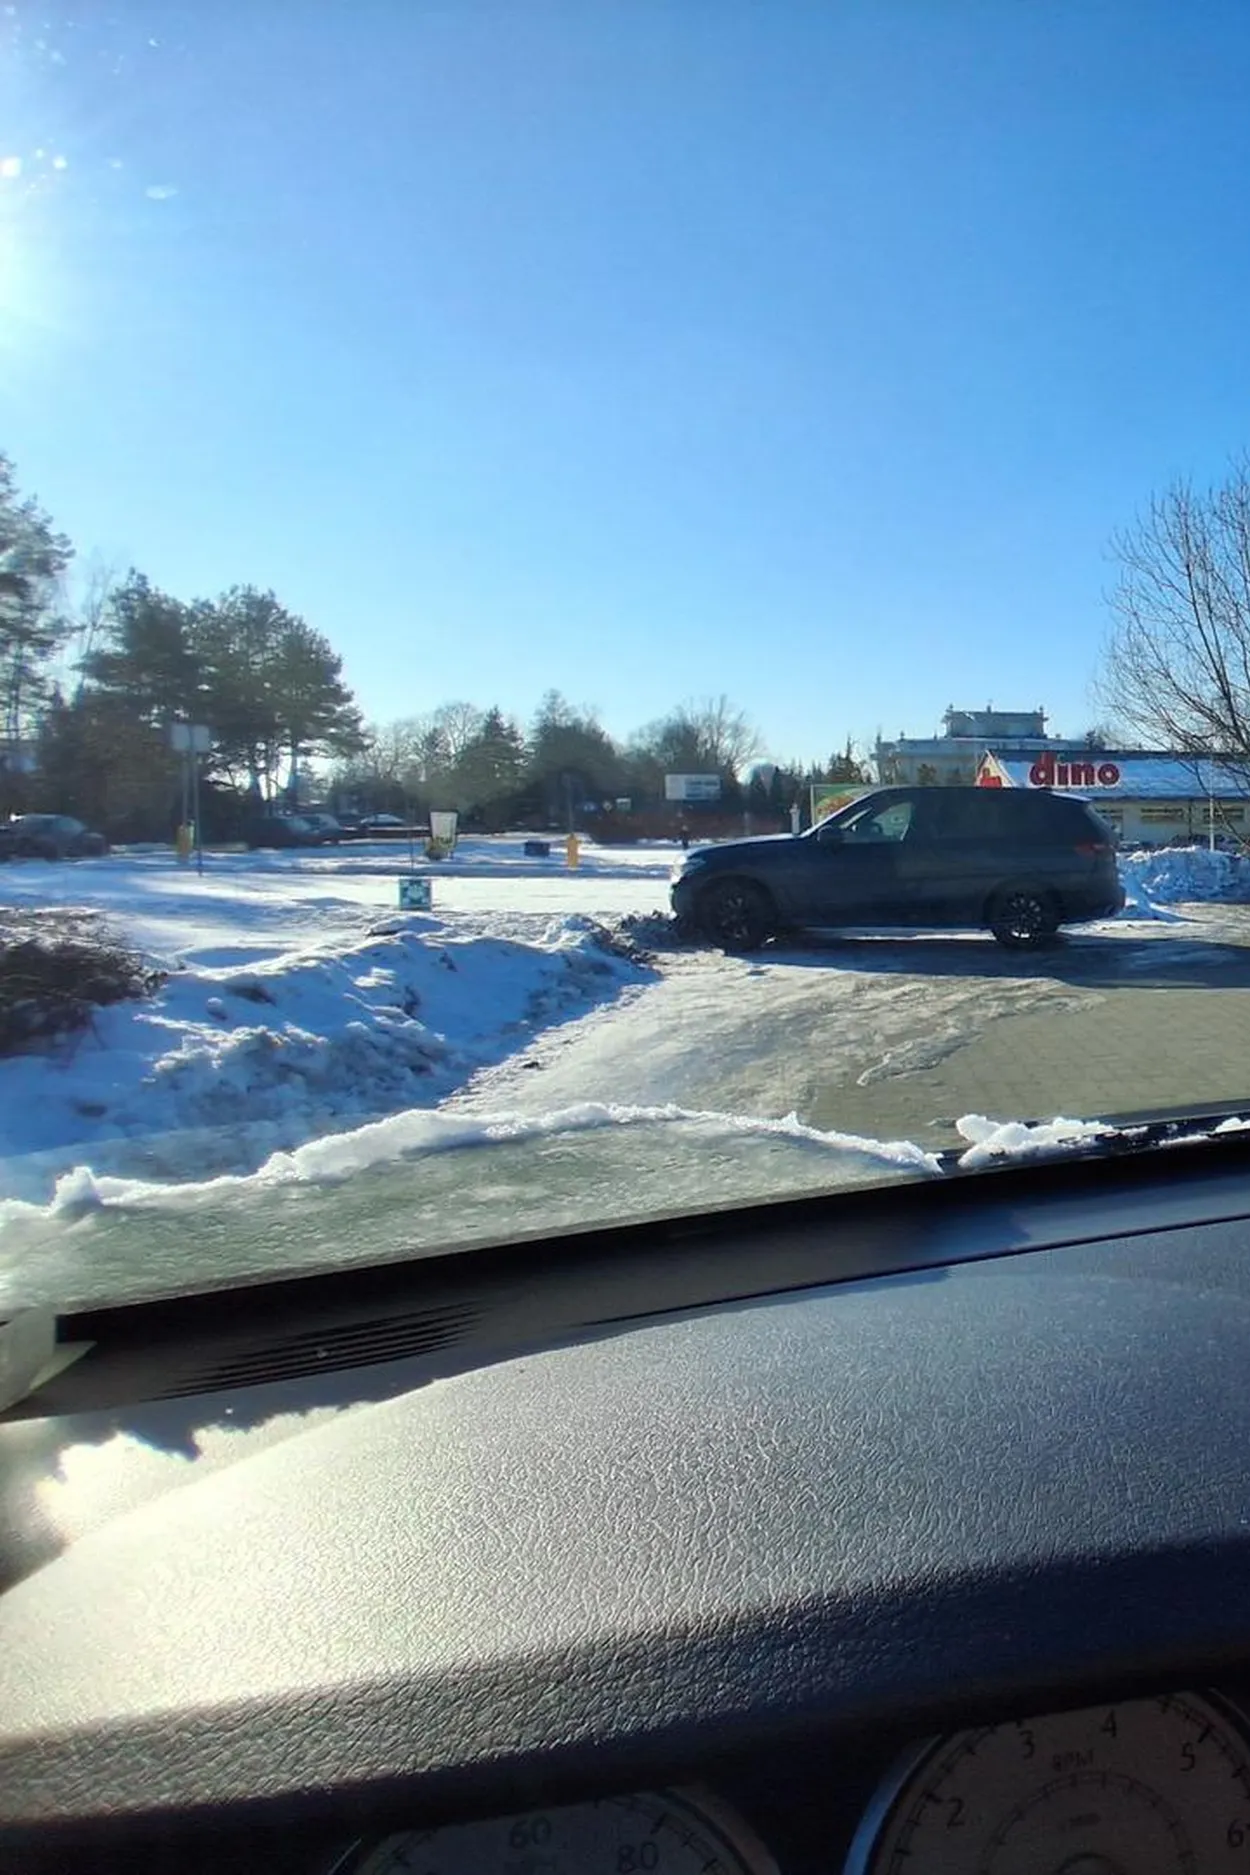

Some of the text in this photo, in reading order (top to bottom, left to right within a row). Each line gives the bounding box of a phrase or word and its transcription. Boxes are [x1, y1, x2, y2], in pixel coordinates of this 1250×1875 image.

[1029, 751, 1121, 786] dino
[1100, 1709, 1119, 1739] 4
[1018, 1729, 1036, 1761] 3
[1179, 1741, 1197, 1773] 5
[946, 1797, 966, 1828] 2
[509, 1815, 553, 1850] 60
[1226, 1818, 1246, 1849] 6
[616, 1840, 660, 1874] 80
